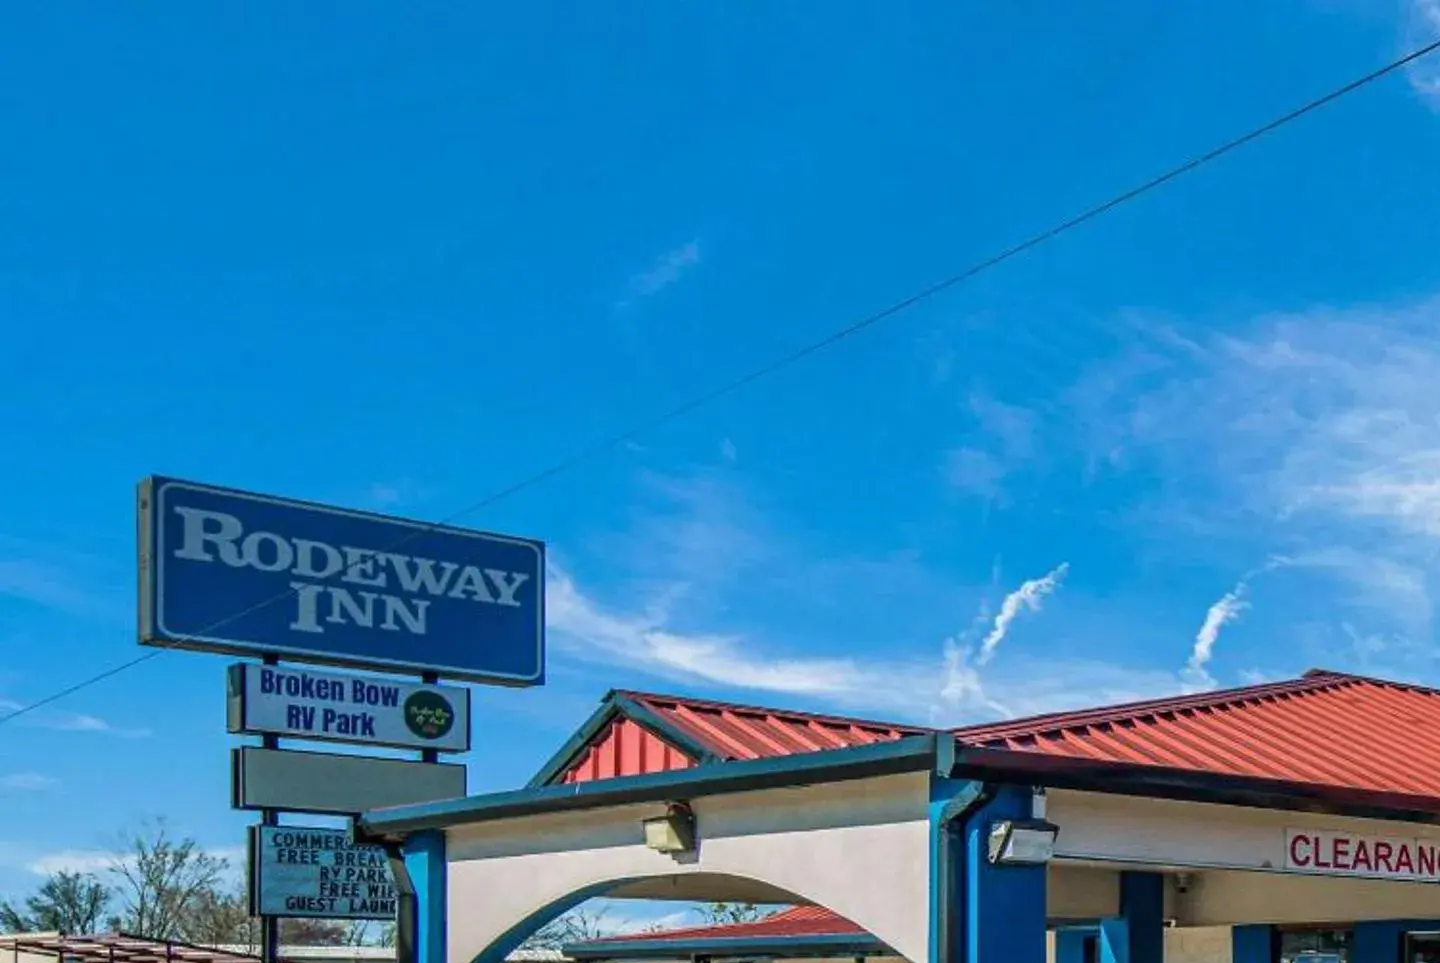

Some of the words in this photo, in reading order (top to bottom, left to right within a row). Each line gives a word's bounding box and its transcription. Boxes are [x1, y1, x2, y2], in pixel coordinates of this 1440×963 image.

[173, 505, 530, 607] RODEWAY
[289, 580, 432, 635] INN
[260, 669, 345, 702] Broken
[352, 679, 400, 708] Bow
[287, 704, 316, 731] RV
[322, 708, 376, 738] Park
[277, 848, 320, 865] FREE
[320, 866, 342, 881] RV
[346, 867, 388, 883] PARK
[320, 882, 360, 897] FREE
[286, 896, 337, 912] GUEST
